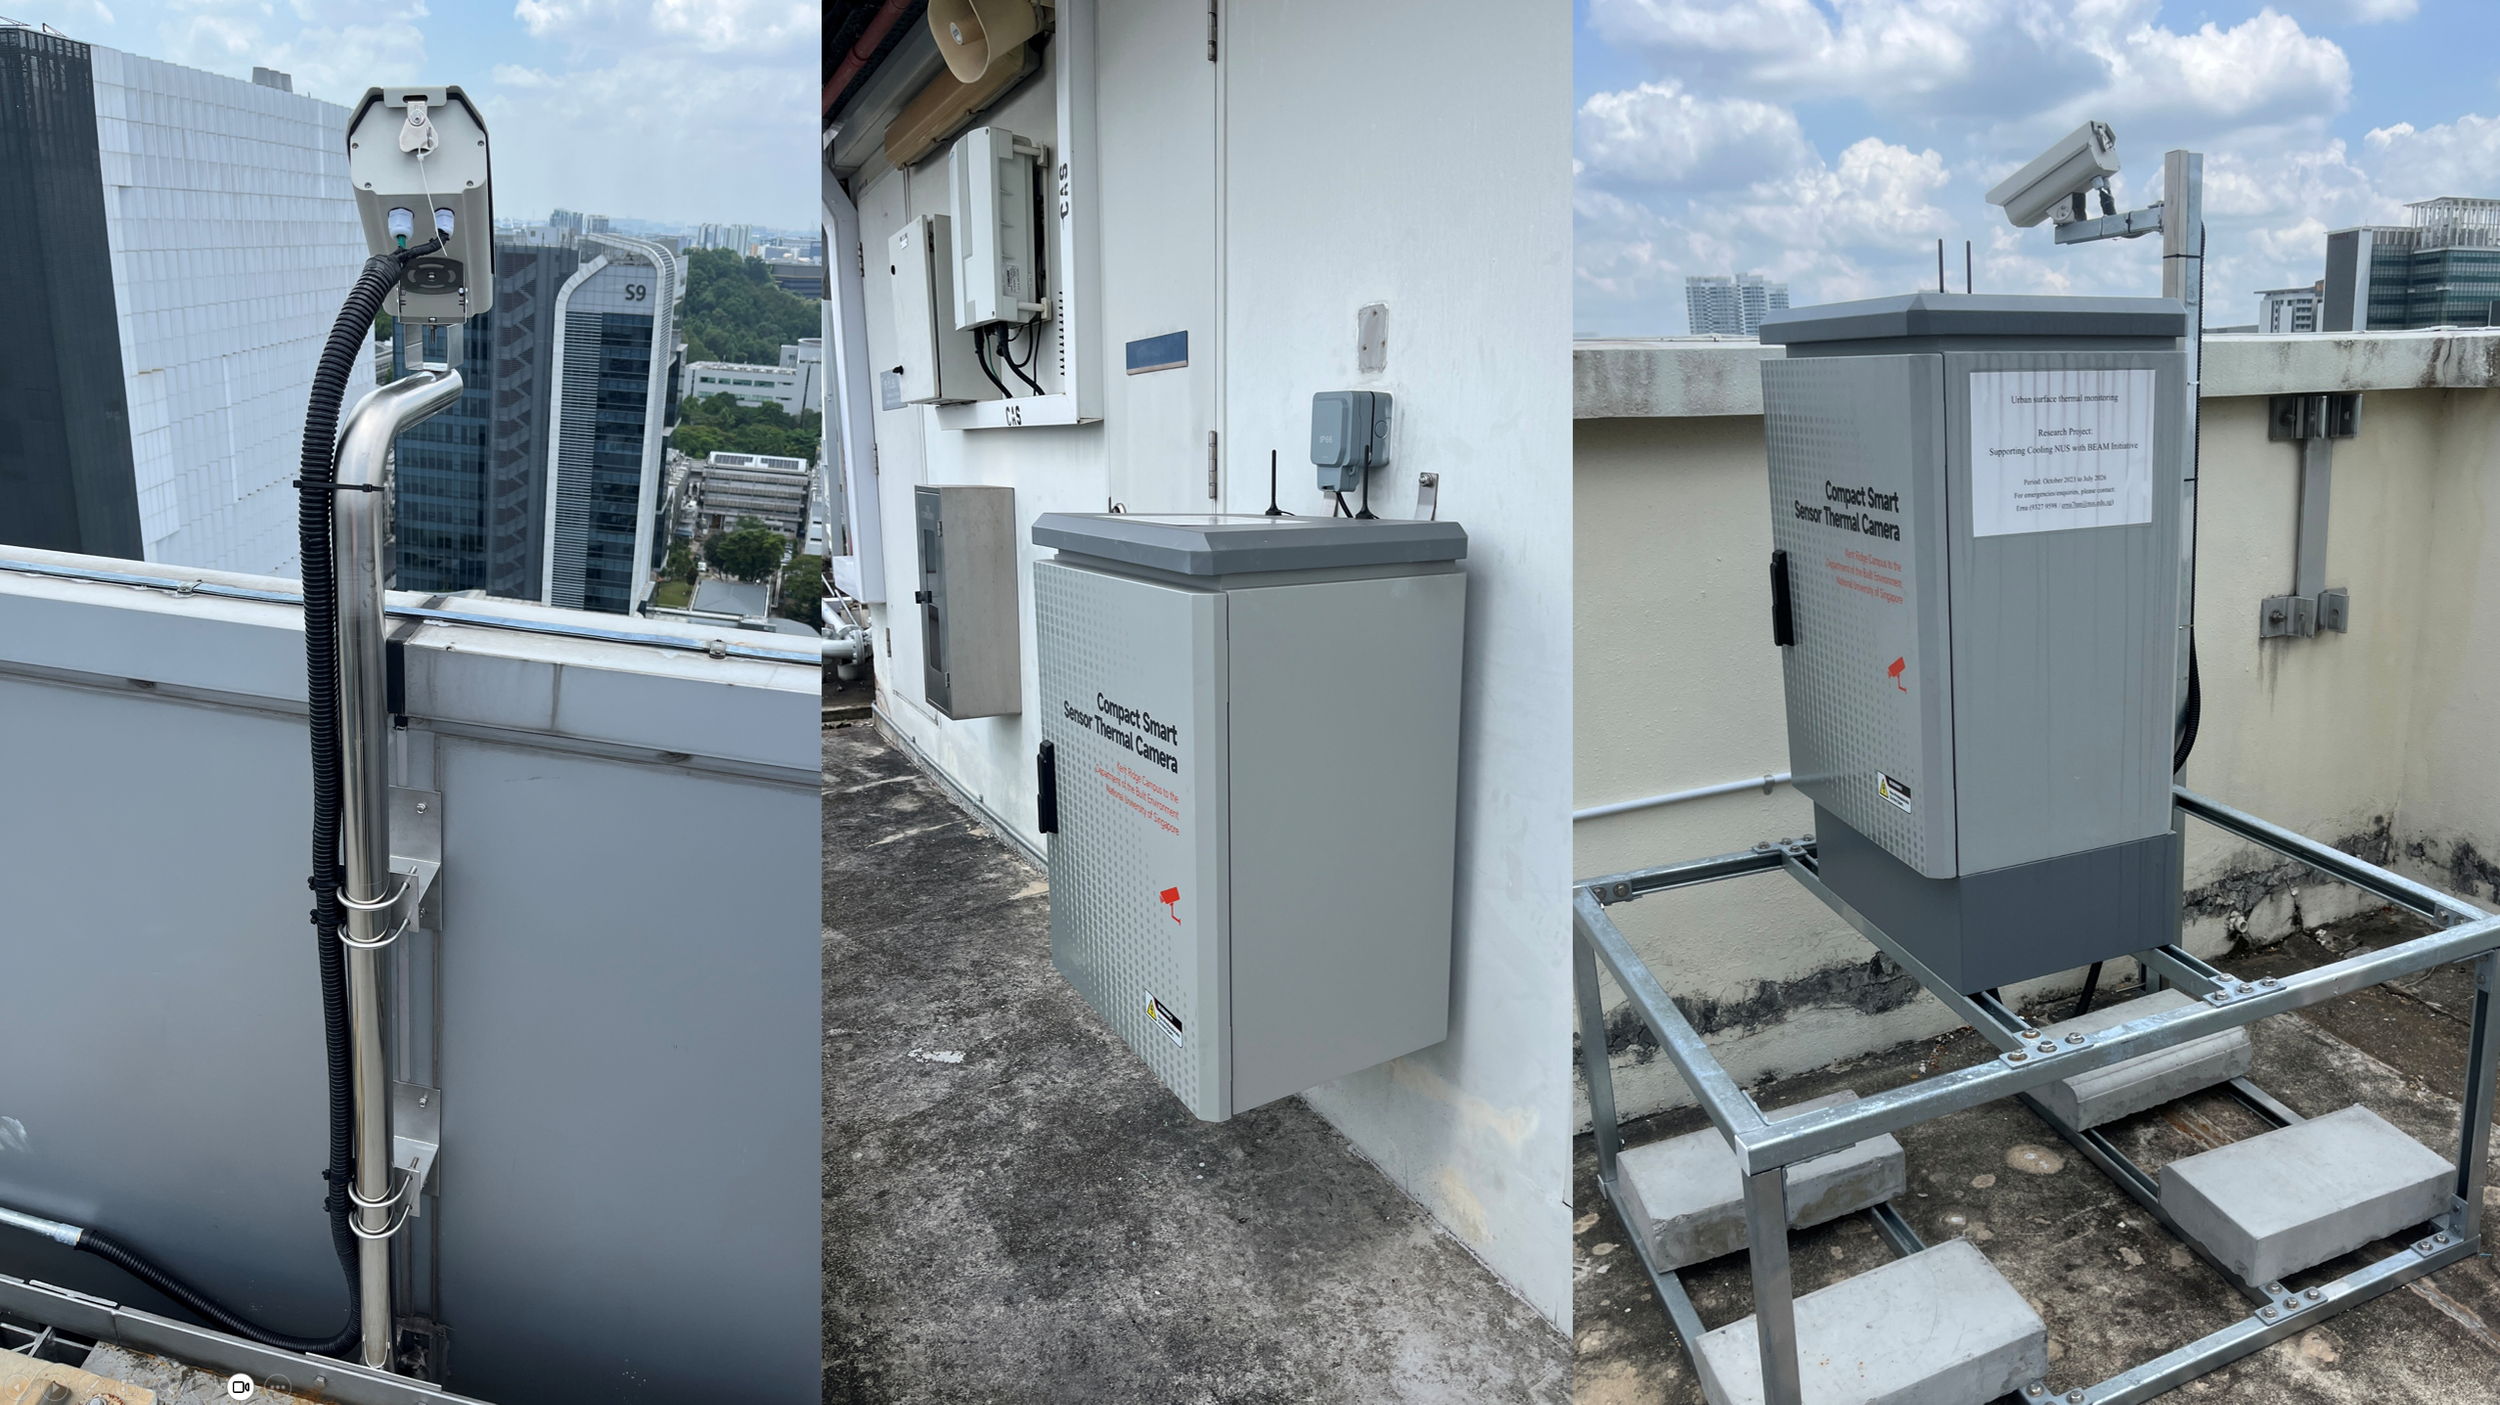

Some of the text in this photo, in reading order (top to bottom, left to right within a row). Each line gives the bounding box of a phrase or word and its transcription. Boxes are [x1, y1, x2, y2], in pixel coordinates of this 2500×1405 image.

[1059, 162, 1069, 220] CAS
[625, 284, 646, 302] S9
[1006, 406, 1021, 426] CAS
[2038, 428, 2093, 437] Research Project:
[1989, 447, 2026, 457] Supporting
[2027, 446, 2053, 455] Cooling
[2055, 444, 2070, 453] NUS
[2088, 443, 2109, 451] BEAM
[2111, 442, 2138, 450] Initiative
[1826, 480, 1899, 513] Compact Smart
[1795, 500, 1900, 541] Sensor Thermal Camera
[1826, 558, 1849, 573] Department
[1863, 568, 1873, 580] Built
[1845, 548, 1902, 572] Kent Ridge Campus to the
[1836, 575, 1852, 588] National
[1854, 581, 1873, 598] University
[1880, 588, 1903, 604] Singapore
[1097, 692, 1178, 746] Compact Smart
[1064, 700, 1178, 774] Sensor Thermal Camera
[1096, 763, 1121, 786] Department
[1122, 780, 1126, 788] of
[1136, 786, 1146, 801] Built
[1147, 793, 1179, 820] Environment
[1117, 761, 1179, 804] Kent Ridge Campus to the
[1106, 783, 1179, 836] National University of Singapore
